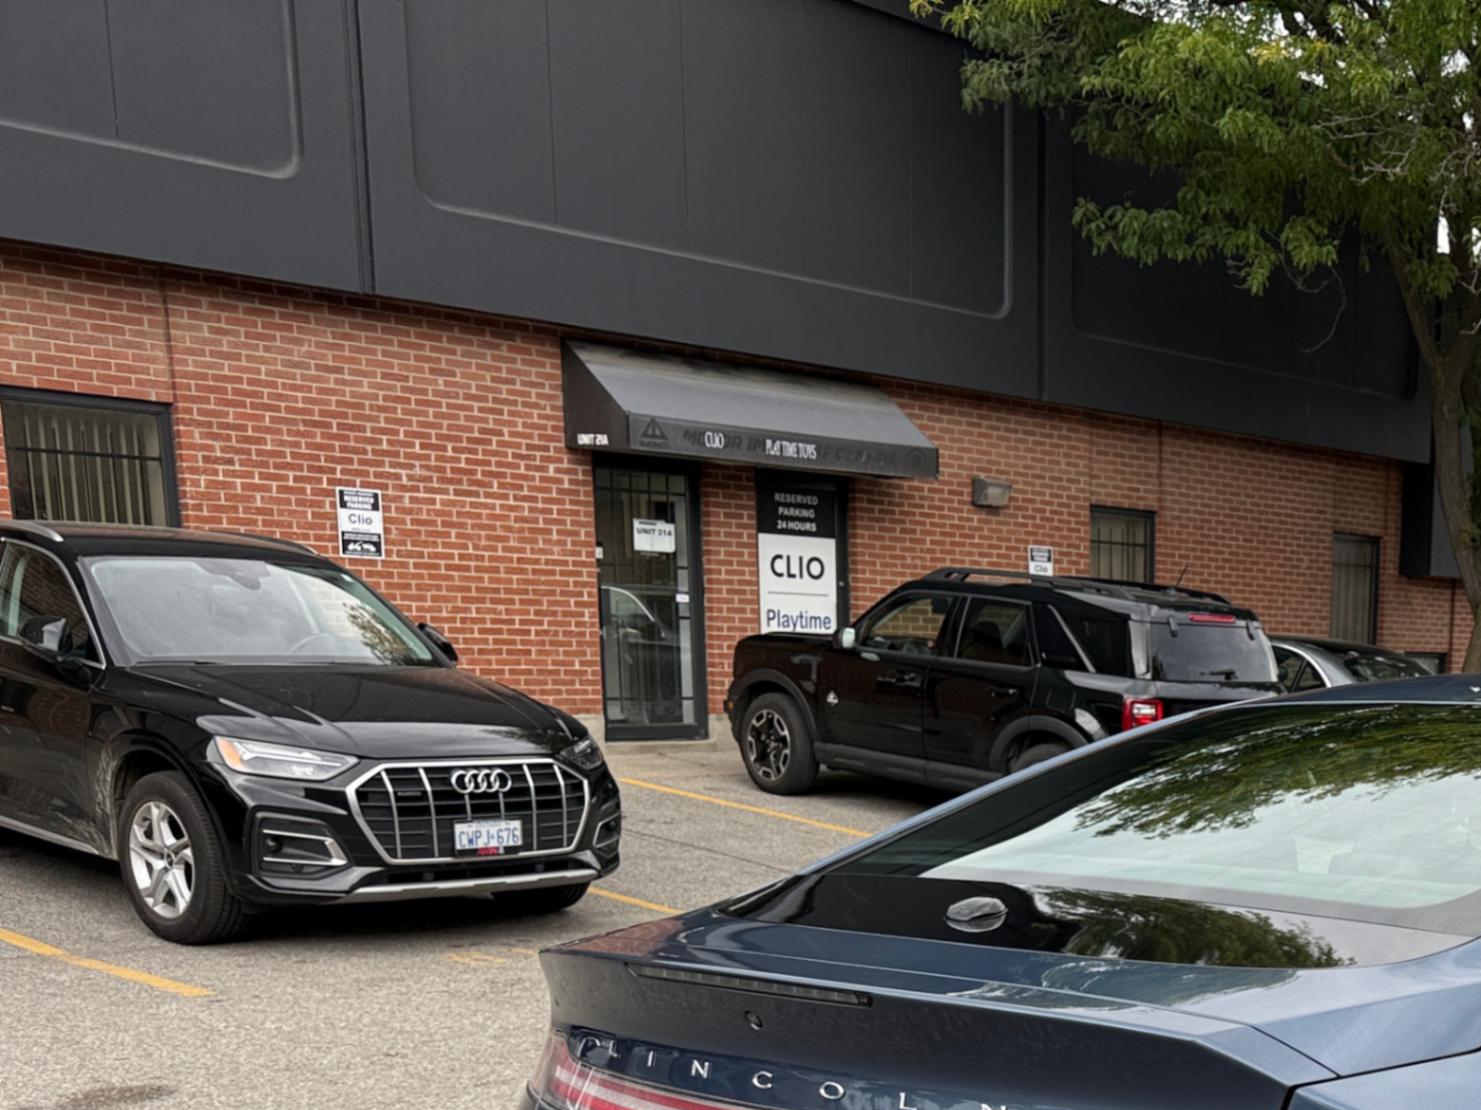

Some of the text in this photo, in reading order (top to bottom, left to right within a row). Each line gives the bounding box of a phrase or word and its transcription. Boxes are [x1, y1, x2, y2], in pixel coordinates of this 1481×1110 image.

[704, 431, 725, 449] CLIO
[774, 492, 818, 505] RESERVED
[348, 513, 373, 525] Clio
[778, 506, 816, 519] PARKING
[636, 527, 673, 536] UNIT 21A
[777, 519, 817, 532] 24 HOURS
[770, 554, 825, 580] CLIO
[766, 609, 832, 631] Playtime
[496, 827, 520, 846] 676
